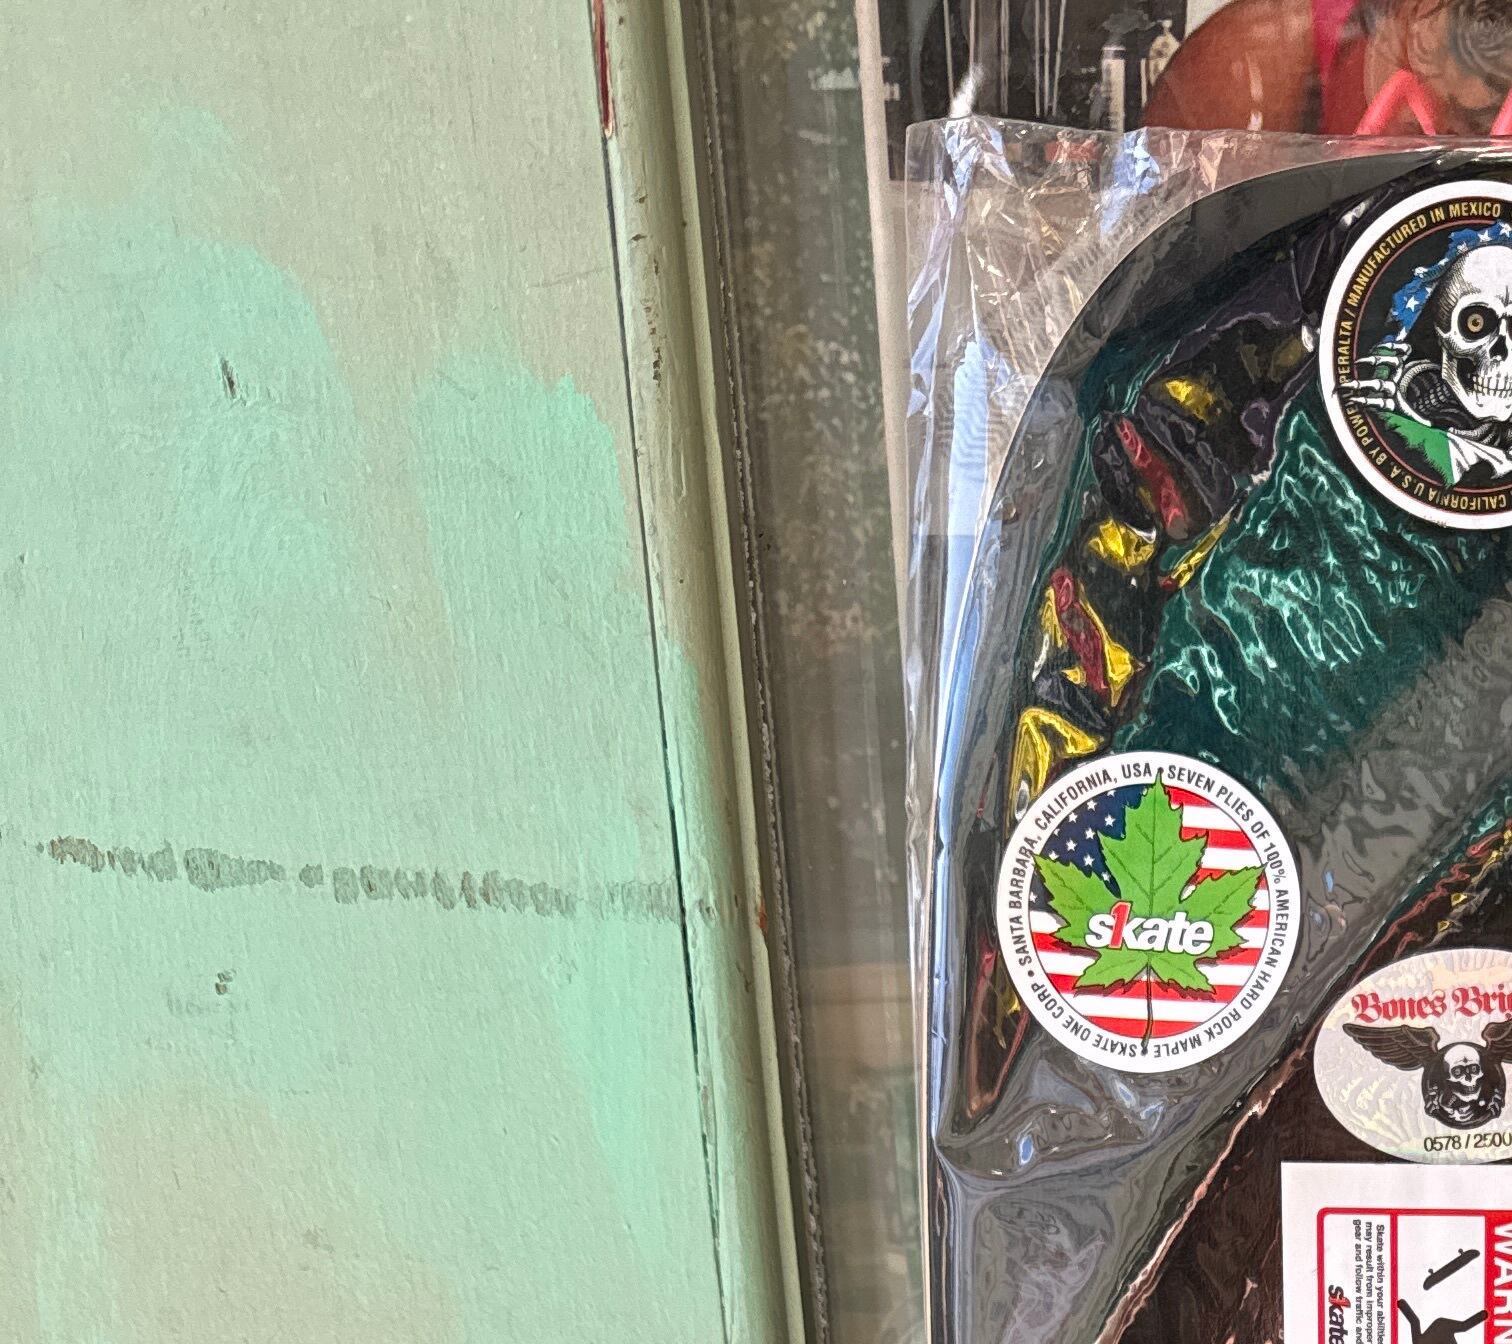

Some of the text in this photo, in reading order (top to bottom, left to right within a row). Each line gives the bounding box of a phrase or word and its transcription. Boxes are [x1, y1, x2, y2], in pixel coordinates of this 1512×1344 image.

[1430, 207, 1445, 224] IN
[1449, 202, 1501, 218] MEXICO
[1347, 214, 1427, 307] MANUFACTURED
[1337, 320, 1354, 385] PERALTA
[1368, 447, 1388, 466] BY
[1389, 462, 1424, 496] U.S.A.
[1428, 487, 1507, 511] CALIFORNIA
[1009, 762, 1289, 1058] SEVEN PLIES OF 100% AMERICAN HARD ROCK MAPLE SKATE ONE CORP SANTA BARBARA, CALIFORNIA, USA
[1351, 989, 1448, 1024] Bones
[1374, 1223, 1385, 1252] Skate
[1375, 1253, 1385, 1284] within
[1373, 1285, 1383, 1309] your
